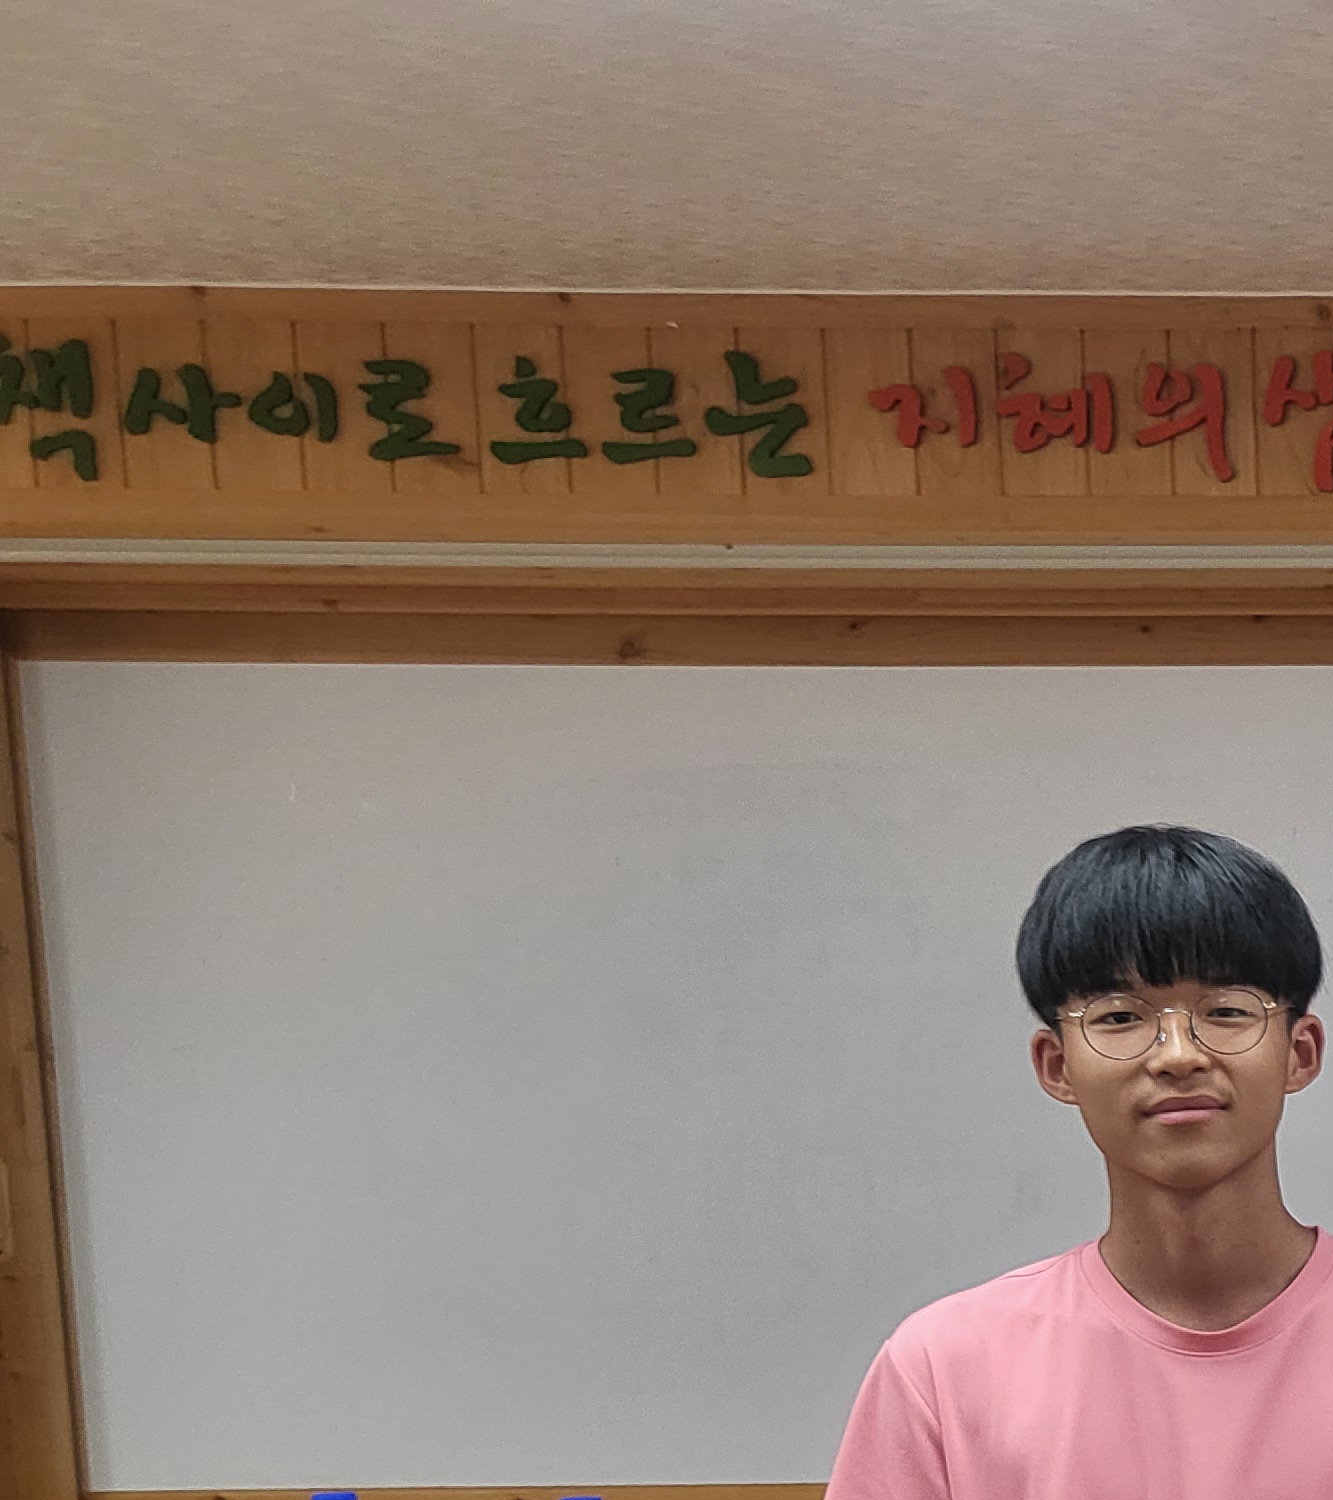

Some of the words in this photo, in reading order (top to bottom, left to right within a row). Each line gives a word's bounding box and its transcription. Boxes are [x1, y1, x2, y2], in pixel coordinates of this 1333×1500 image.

[124, 359, 461, 462] 사이로
[490, 350, 813, 478] 흐르는
[868, 352, 1235, 482] 지혜의
